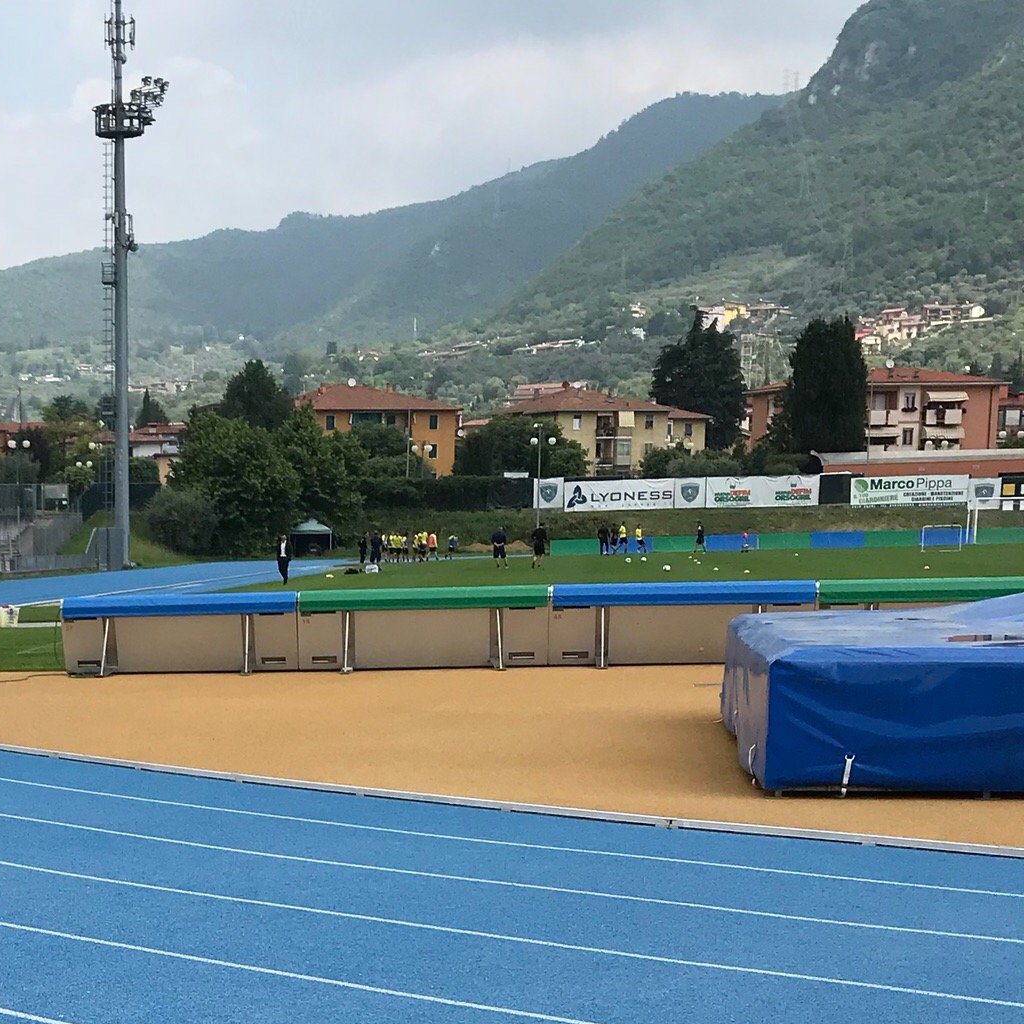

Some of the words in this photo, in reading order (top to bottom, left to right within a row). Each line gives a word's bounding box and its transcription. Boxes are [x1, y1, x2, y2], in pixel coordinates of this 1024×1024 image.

[870, 479, 914, 490] Marco
[916, 477, 952, 490] Pippa
[590, 490, 673, 502] LYONESS
